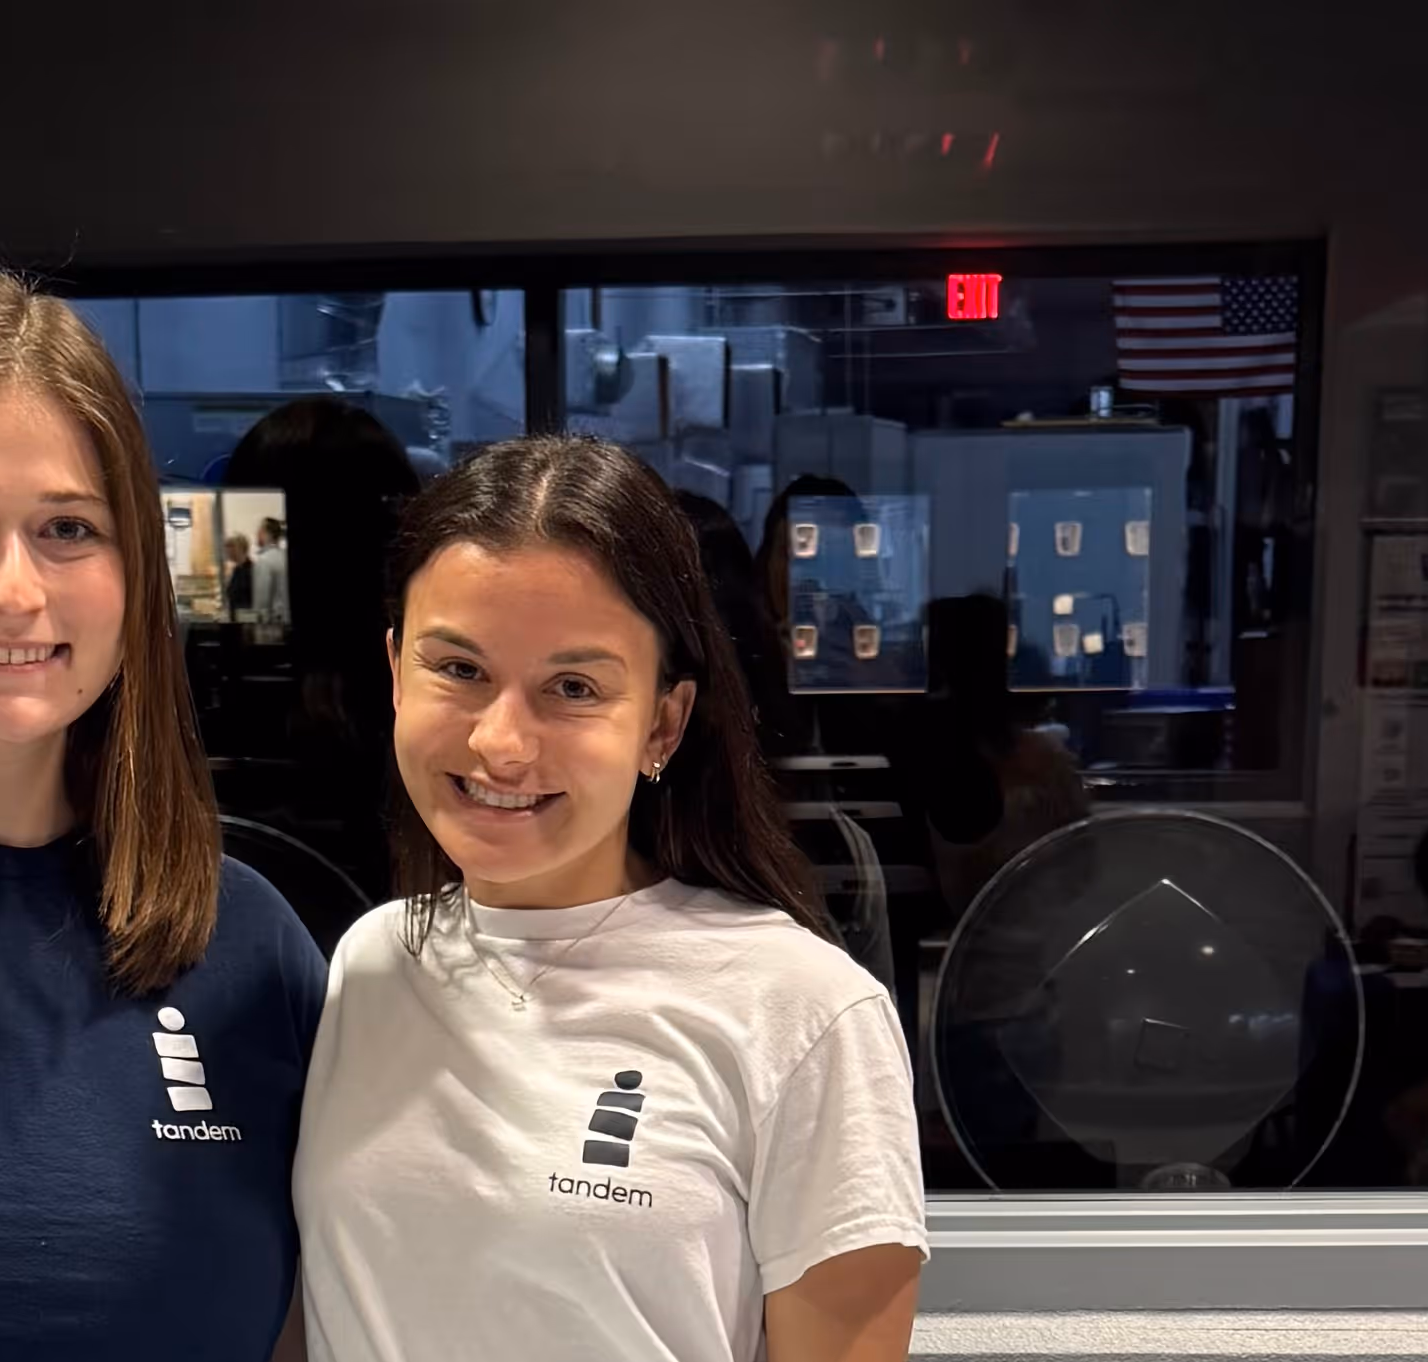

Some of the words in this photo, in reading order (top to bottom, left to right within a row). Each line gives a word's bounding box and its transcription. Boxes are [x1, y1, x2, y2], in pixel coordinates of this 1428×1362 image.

[948, 274, 1002, 319] EXIT
[152, 1120, 241, 1140] tandem
[549, 1173, 652, 1208] tandem
